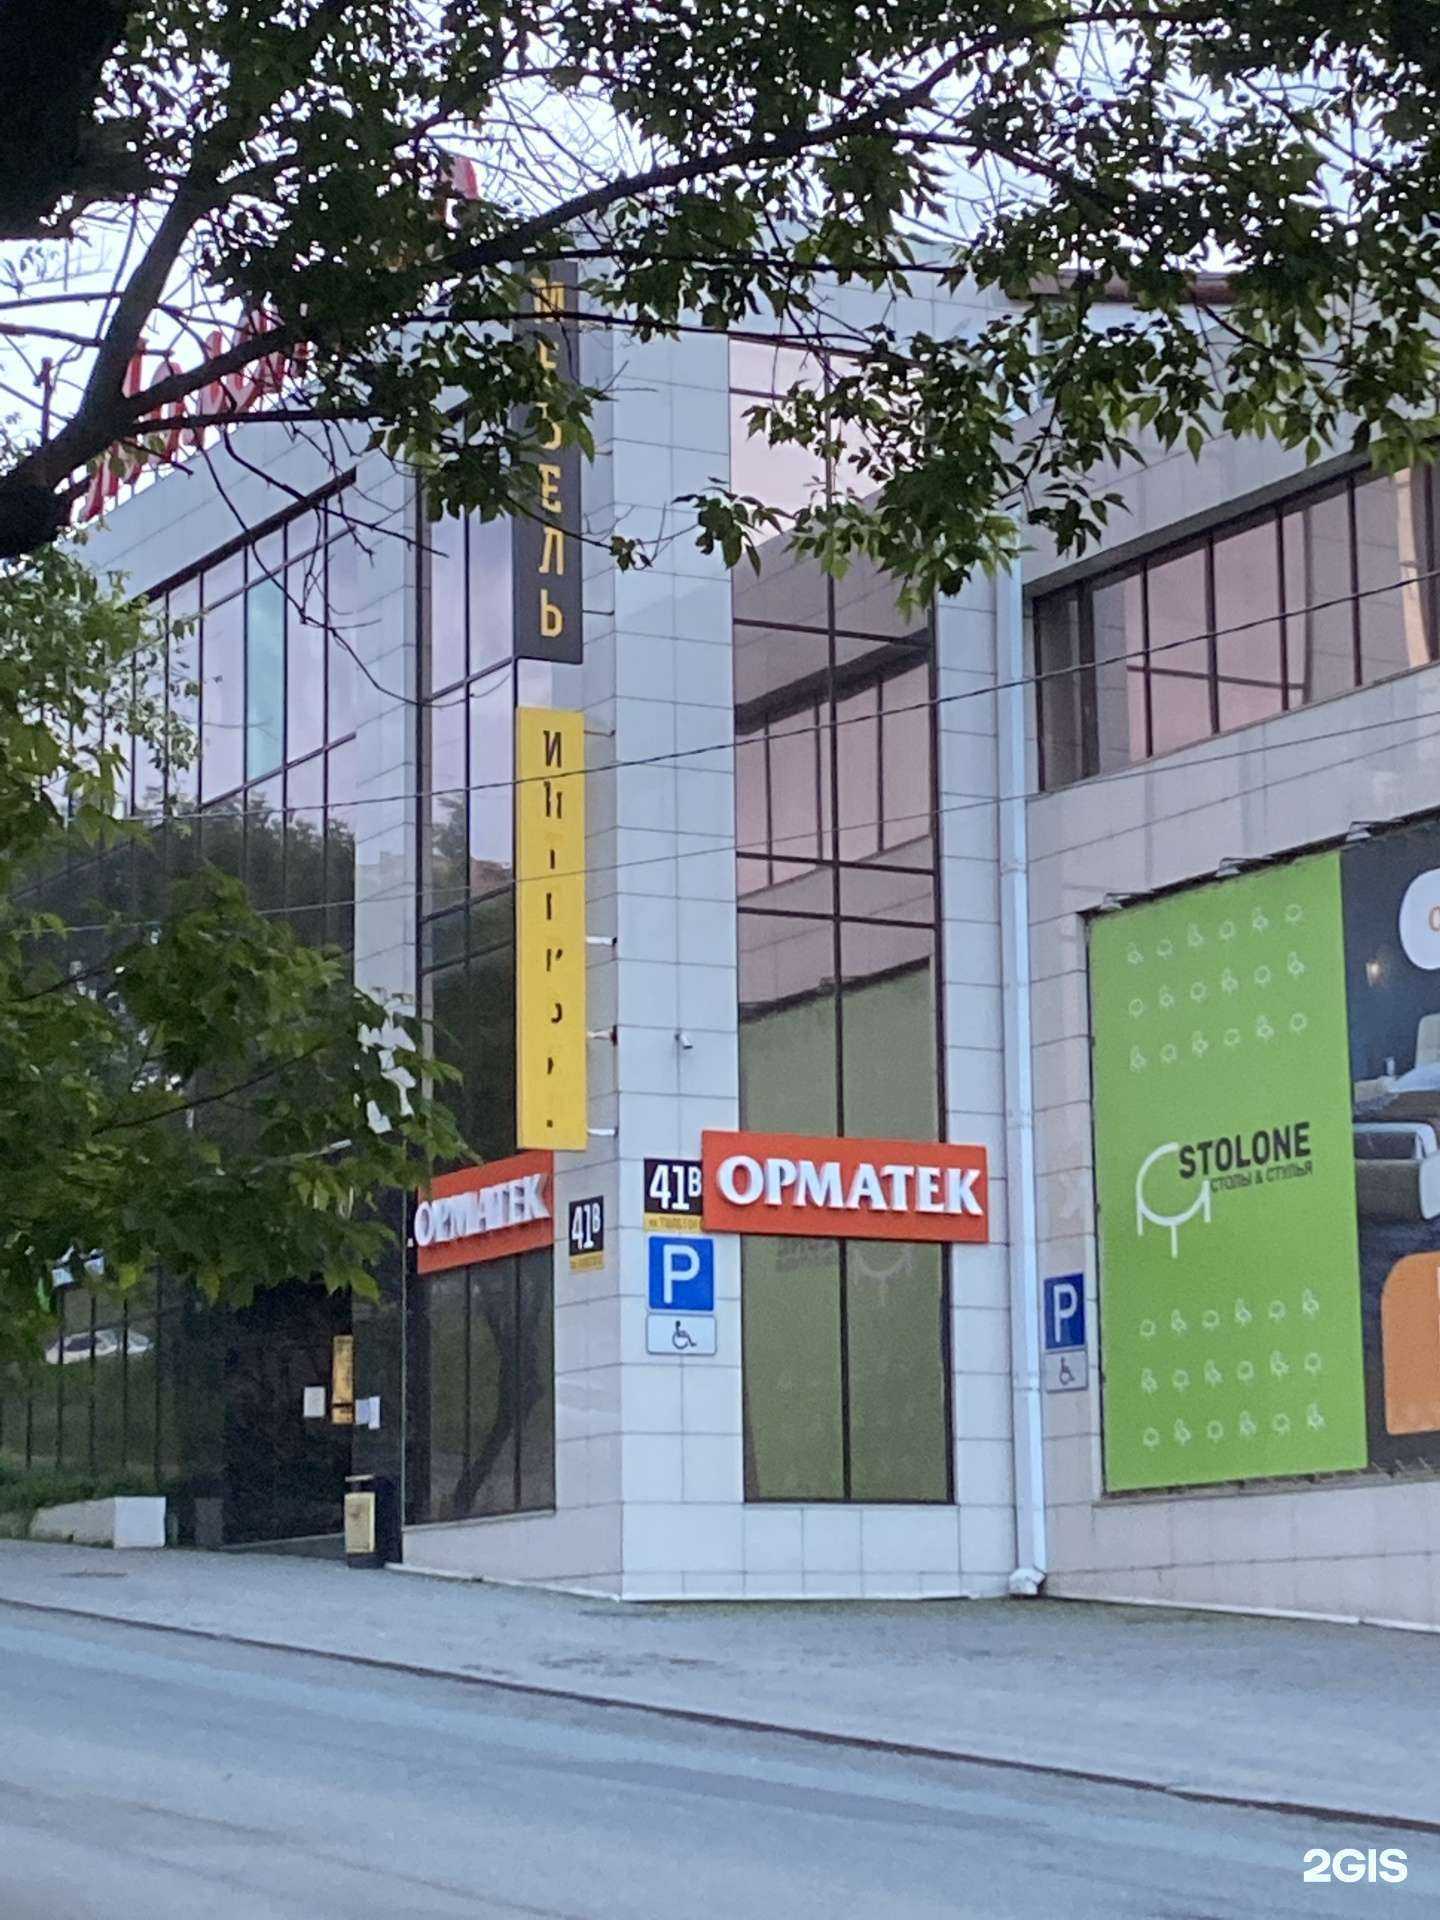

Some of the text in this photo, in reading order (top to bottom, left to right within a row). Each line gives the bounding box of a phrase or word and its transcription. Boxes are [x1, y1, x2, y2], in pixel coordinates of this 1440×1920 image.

[1179, 1121, 1312, 1179] STOLONE
[414, 1174, 550, 1247] ОРМАТЕК
[717, 1155, 984, 1216] ОРМАТЕК
[663, 1244, 700, 1303] P
[1053, 1283, 1078, 1343] P
